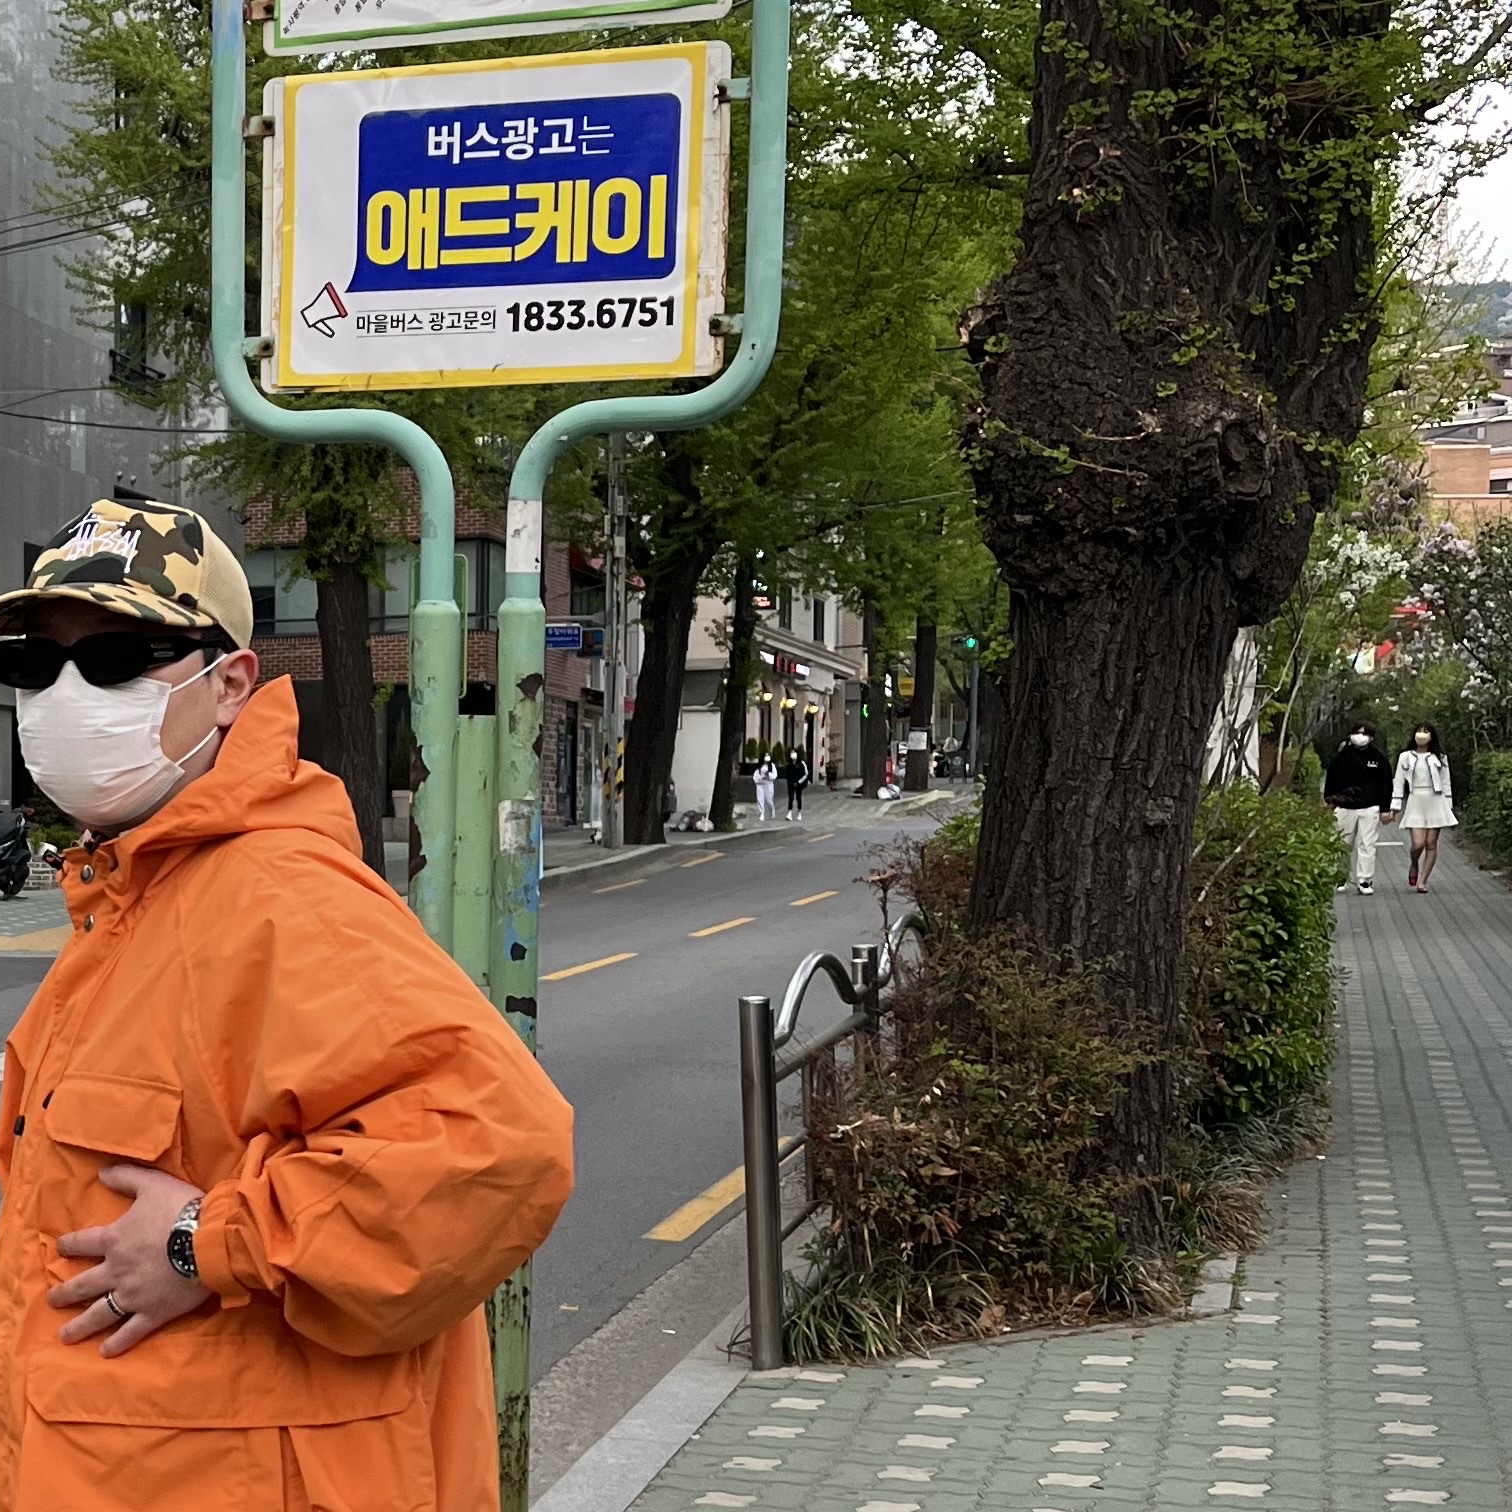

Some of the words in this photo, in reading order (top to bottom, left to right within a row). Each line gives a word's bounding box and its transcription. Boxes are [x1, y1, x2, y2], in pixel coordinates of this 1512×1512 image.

[427, 116, 615, 165] 버스광고는
[366, 174, 668, 271] 애드케이
[356, 313, 424, 334] 마을버스
[428, 309, 497, 332] 광고문의
[506, 296, 675, 333] 1833.6751
